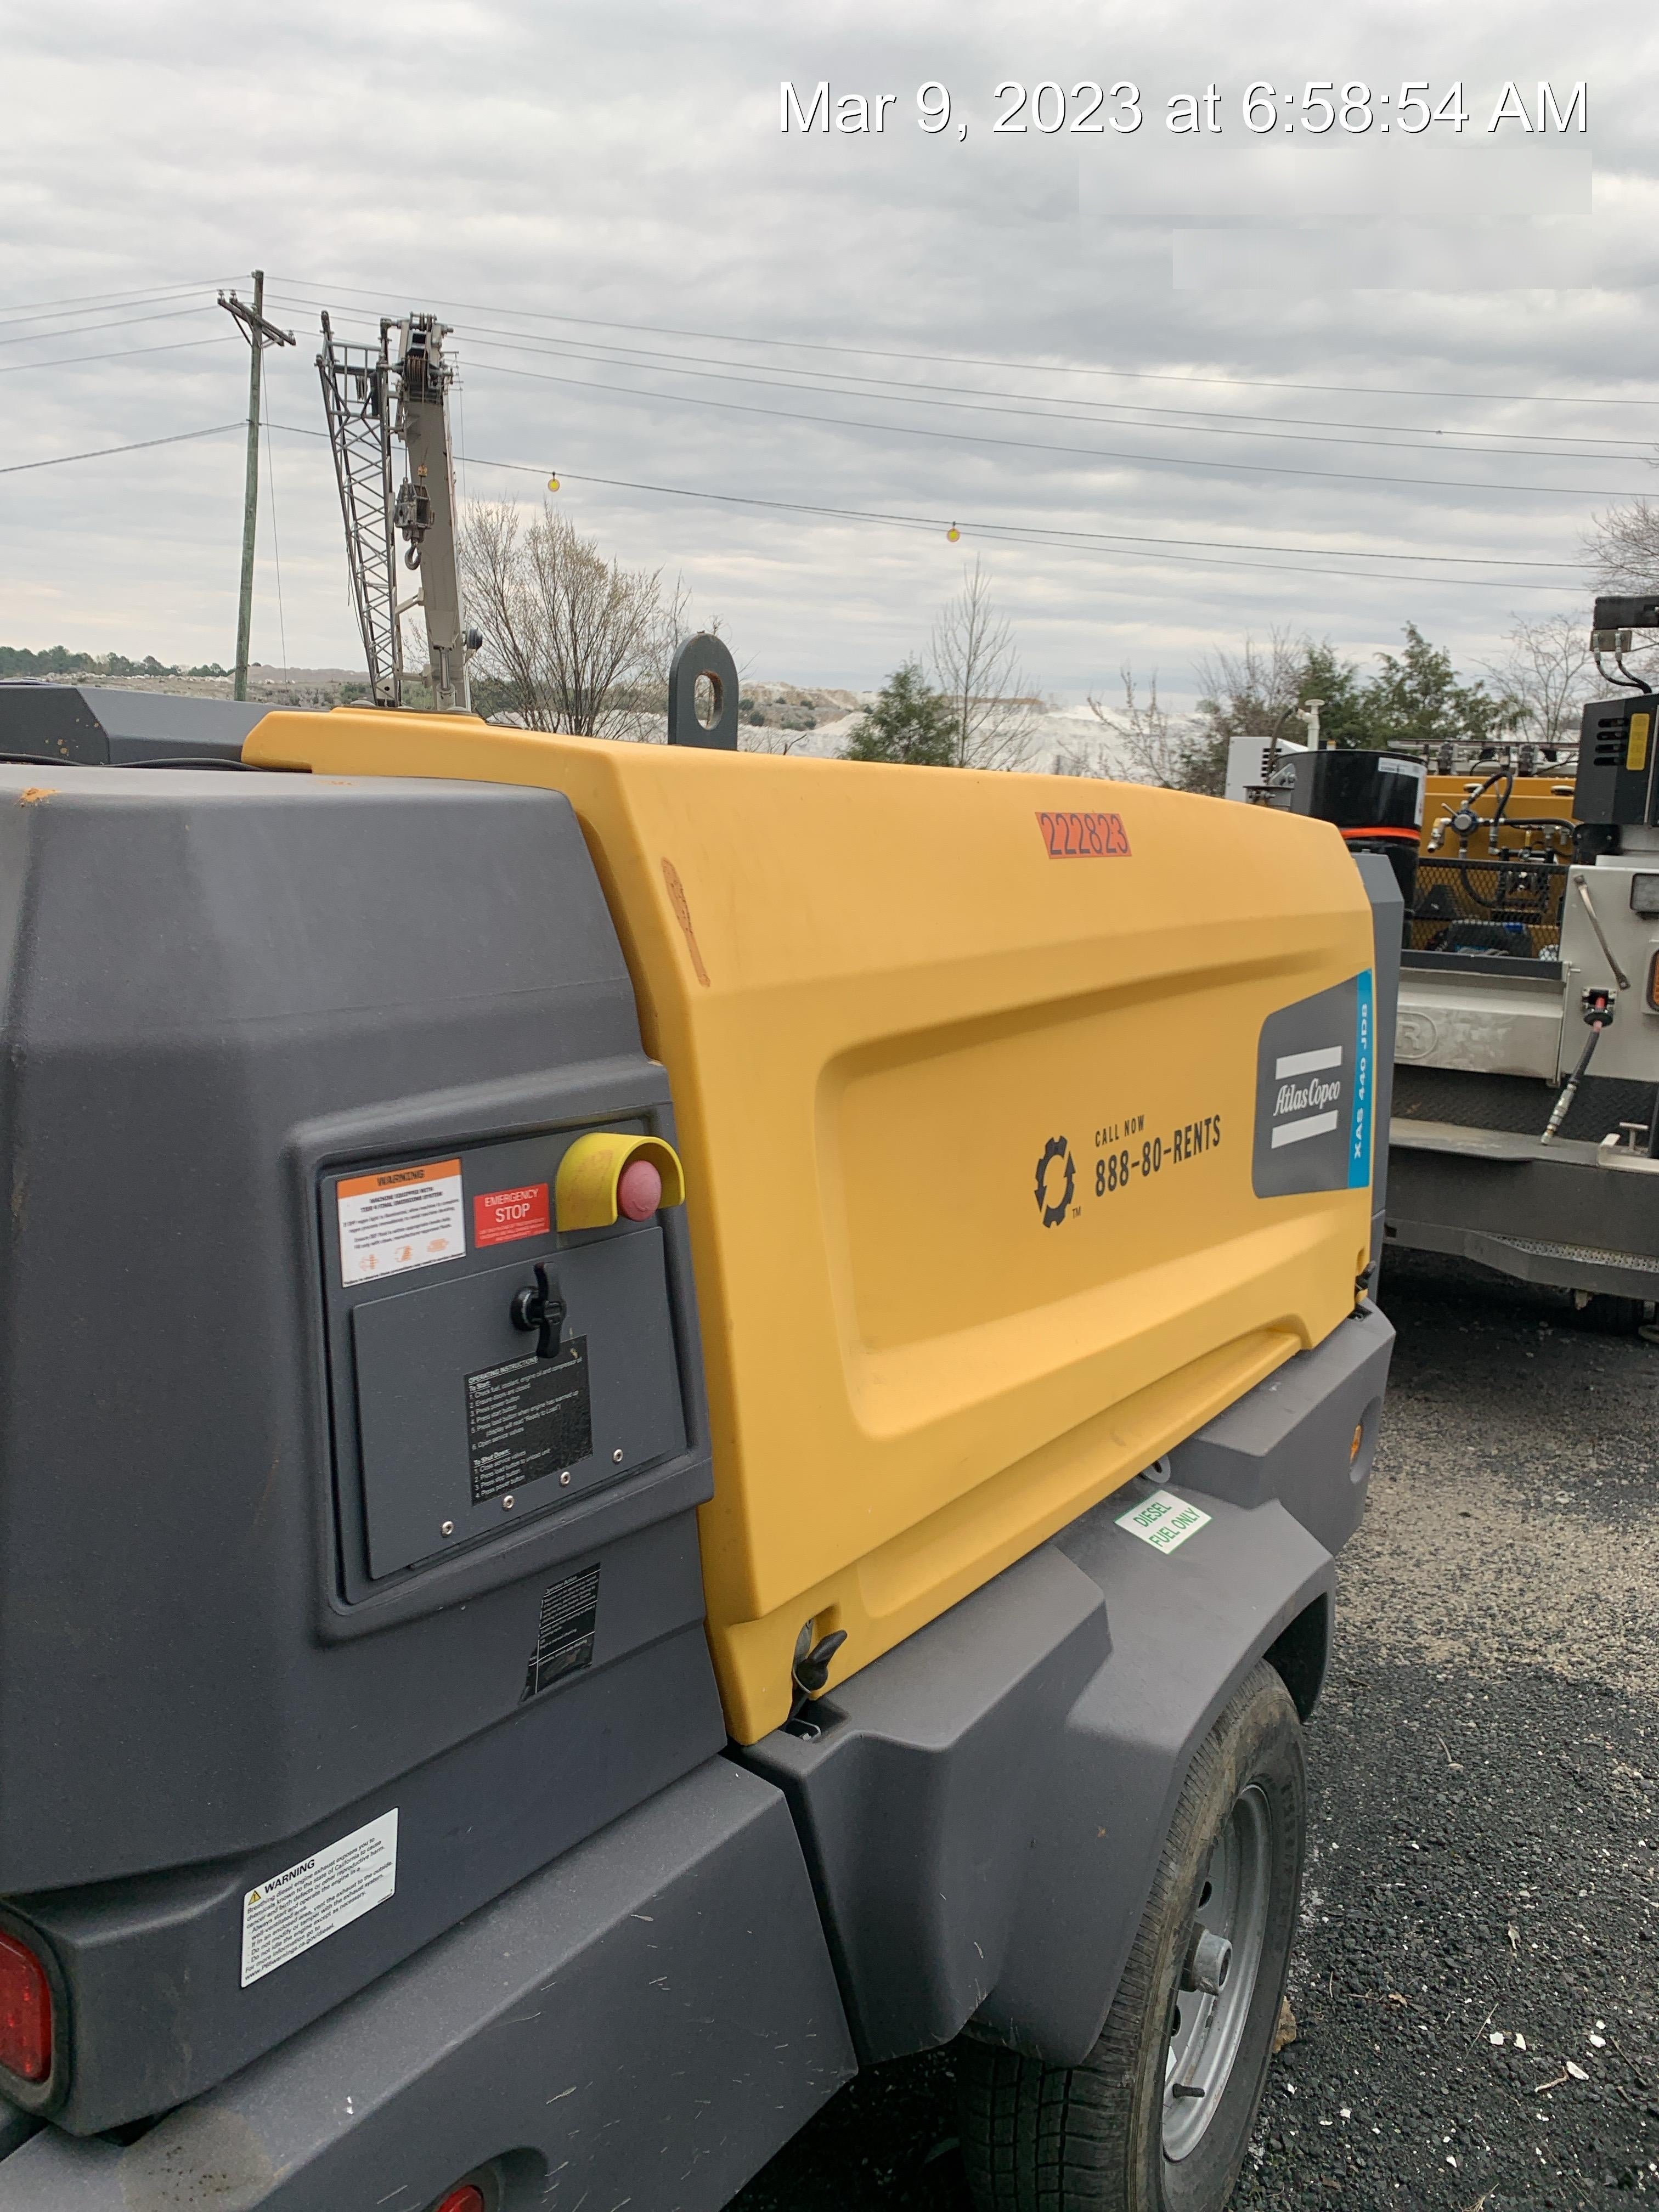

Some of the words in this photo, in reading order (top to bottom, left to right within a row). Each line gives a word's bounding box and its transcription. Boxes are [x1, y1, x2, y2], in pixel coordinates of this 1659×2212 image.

[1041, 813, 1127, 855] 222823
[1095, 1124, 1120, 1147] CALL
[1124, 1114, 1145, 1136] NOW
[1355, 1108, 1364, 1159] XAS
[1095, 1114, 1221, 1197] 888-80-RENTS
[377, 1169, 424, 1187] WARNING
[484, 1188, 539, 1207] EMERGENCY
[495, 1201, 531, 1223] STOP
[1132, 1502, 1172, 1527] DIESEL
[1148, 1526, 1181, 1547] FUEL
[1171, 1507, 1200, 1530] ONLY
[247, 1893, 275, 1916] Breathing
[276, 1883, 292, 1898] diesel
[294, 1872, 313, 1888] engine
[314, 1859, 335, 1876] exhaust
[336, 1847, 357, 1864] exposes
[358, 1841, 368, 1851] you
[264, 1858, 314, 1895] WARNING
[276, 1889, 295, 1905] known
[303, 1879, 312, 1889] the
[313, 1871, 326, 1883] state
[328, 1867, 333, 1875] of
[335, 1852, 359, 1871] California
[366, 1840, 381, 1852] cause
[336, 1881, 356, 1898] exhaust
[251, 1945, 259, 1955] Do
[261, 1940, 270, 1950] not
[343, 1884, 363, 1900] exhaust
[251, 1953, 259, 1963] Do
[261, 1947, 270, 1957] not
